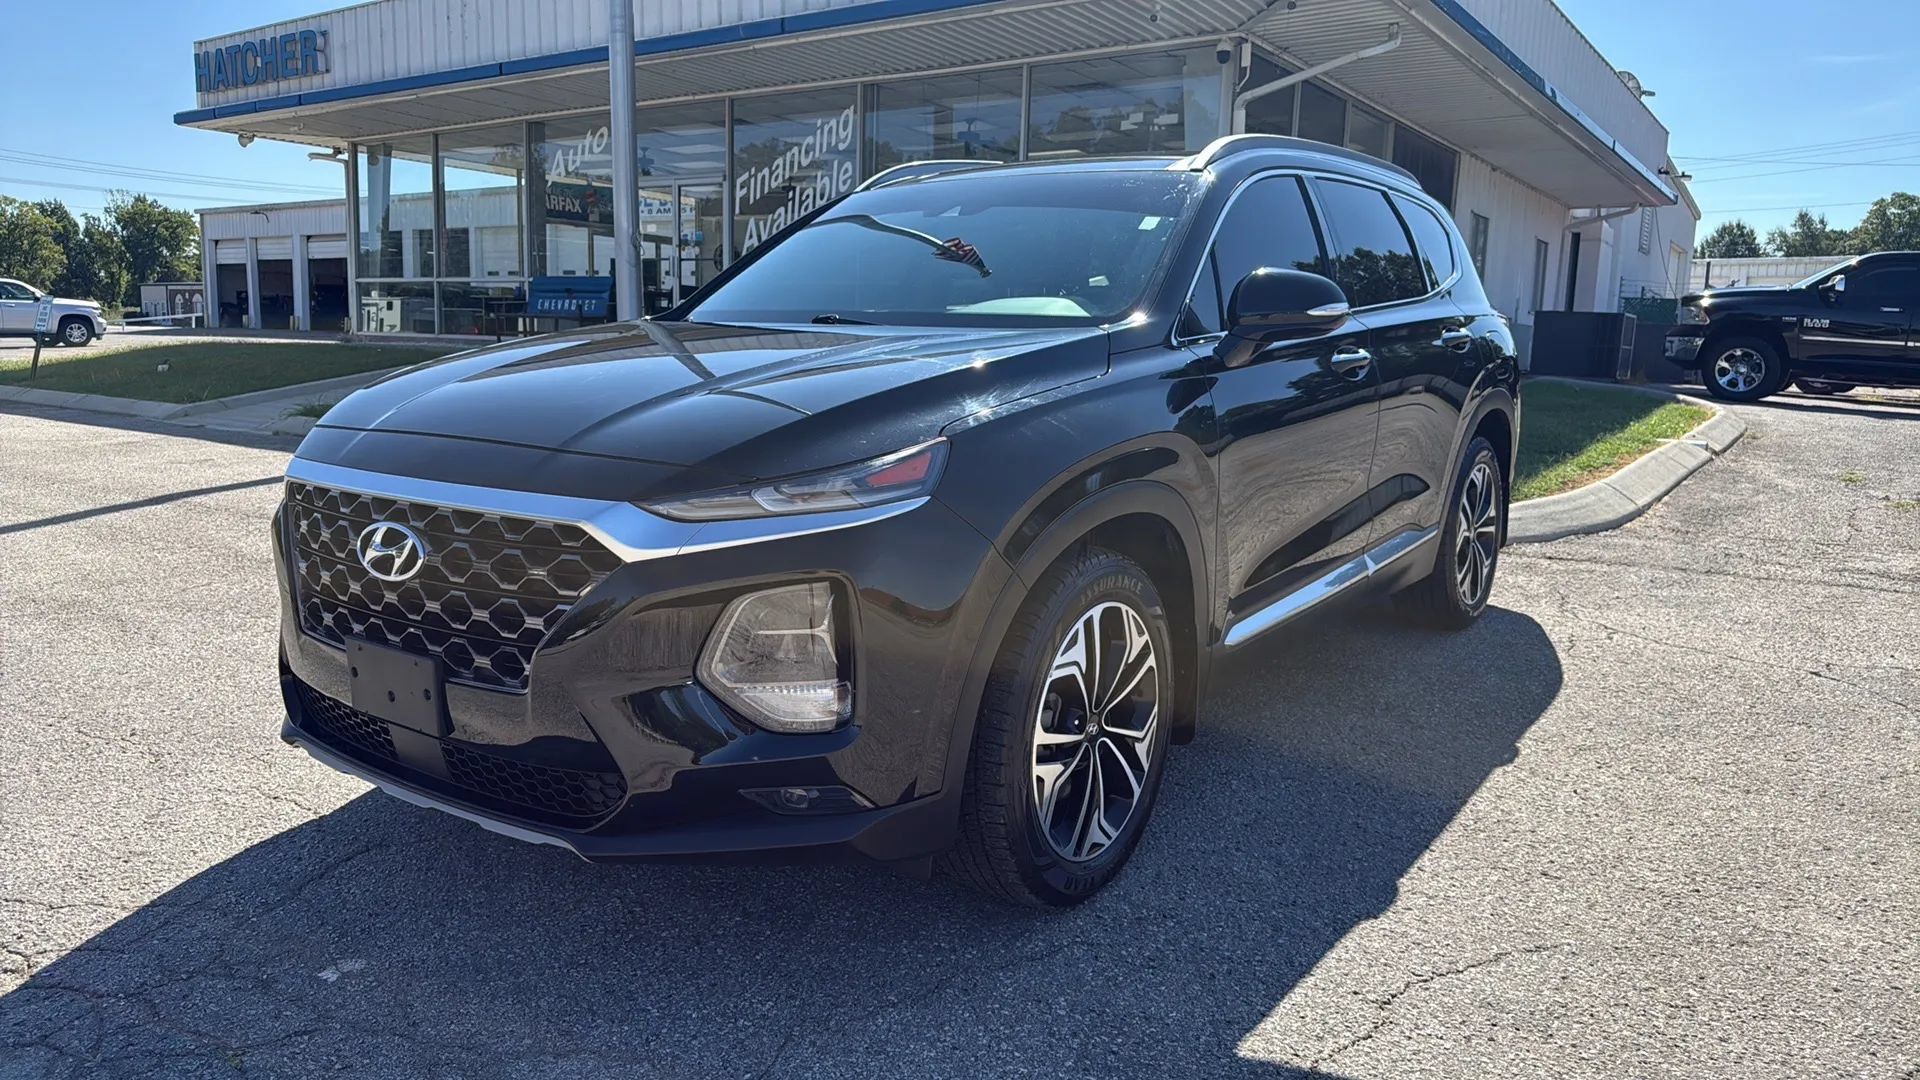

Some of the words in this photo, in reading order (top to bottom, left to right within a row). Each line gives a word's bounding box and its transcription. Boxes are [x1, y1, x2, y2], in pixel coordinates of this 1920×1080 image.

[194, 29, 320, 93] HATCHER
[546, 126, 608, 188] Auto
[734, 104, 856, 215] Financing
[656, 207, 672, 215] AM
[741, 159, 853, 257] Available
